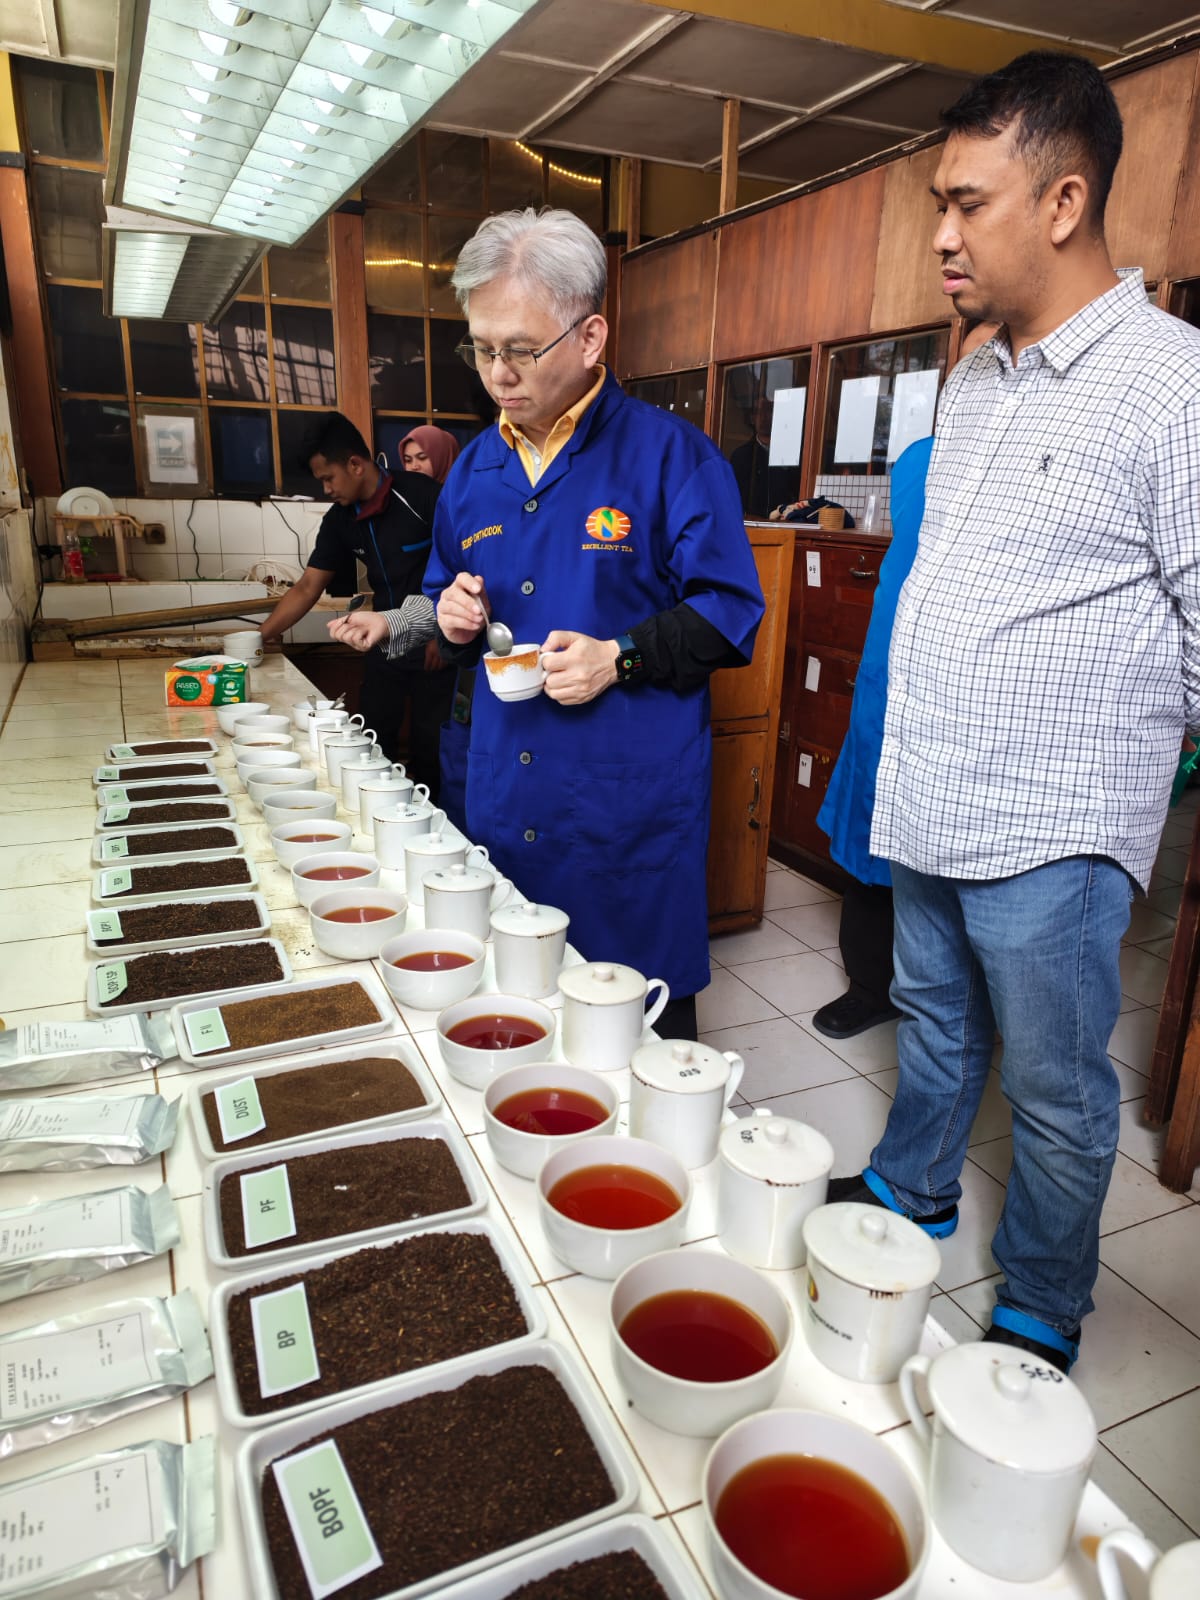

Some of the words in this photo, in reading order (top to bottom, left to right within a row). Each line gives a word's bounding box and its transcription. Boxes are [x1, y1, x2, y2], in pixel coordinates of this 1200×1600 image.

[176, 682, 199, 690] PASEO
[232, 1097, 250, 1119] DUST
[260, 1199, 276, 1213] PF
[277, 1330, 297, 1349] BP
[1020, 1363, 1063, 1382] SED
[308, 1488, 345, 1540] BOPF
